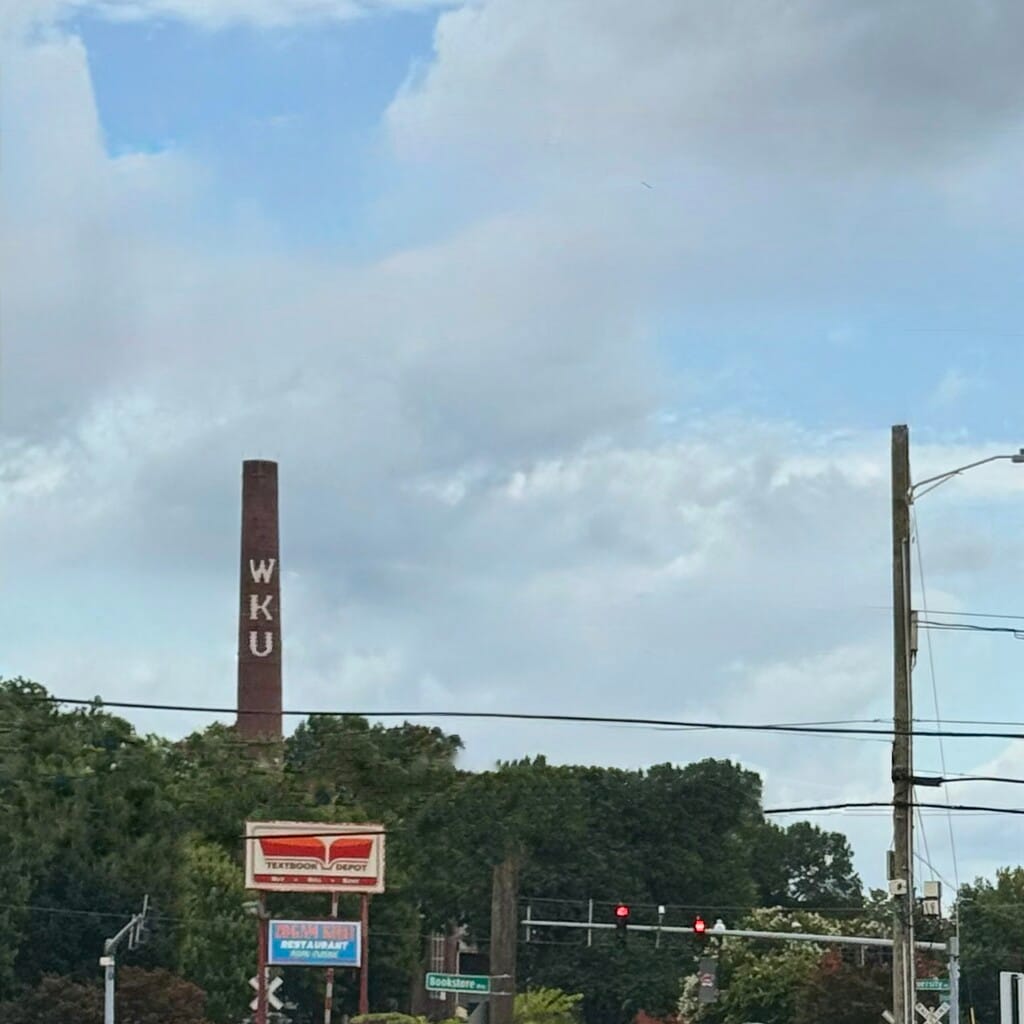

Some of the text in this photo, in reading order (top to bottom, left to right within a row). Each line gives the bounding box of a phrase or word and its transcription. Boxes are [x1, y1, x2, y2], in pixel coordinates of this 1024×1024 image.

[249, 558, 275, 657] WKU
[266, 861, 368, 871] TEXTBOOK DEPOT
[280, 939, 349, 950] RESTAURANT
[429, 976, 475, 989] Bookstore
